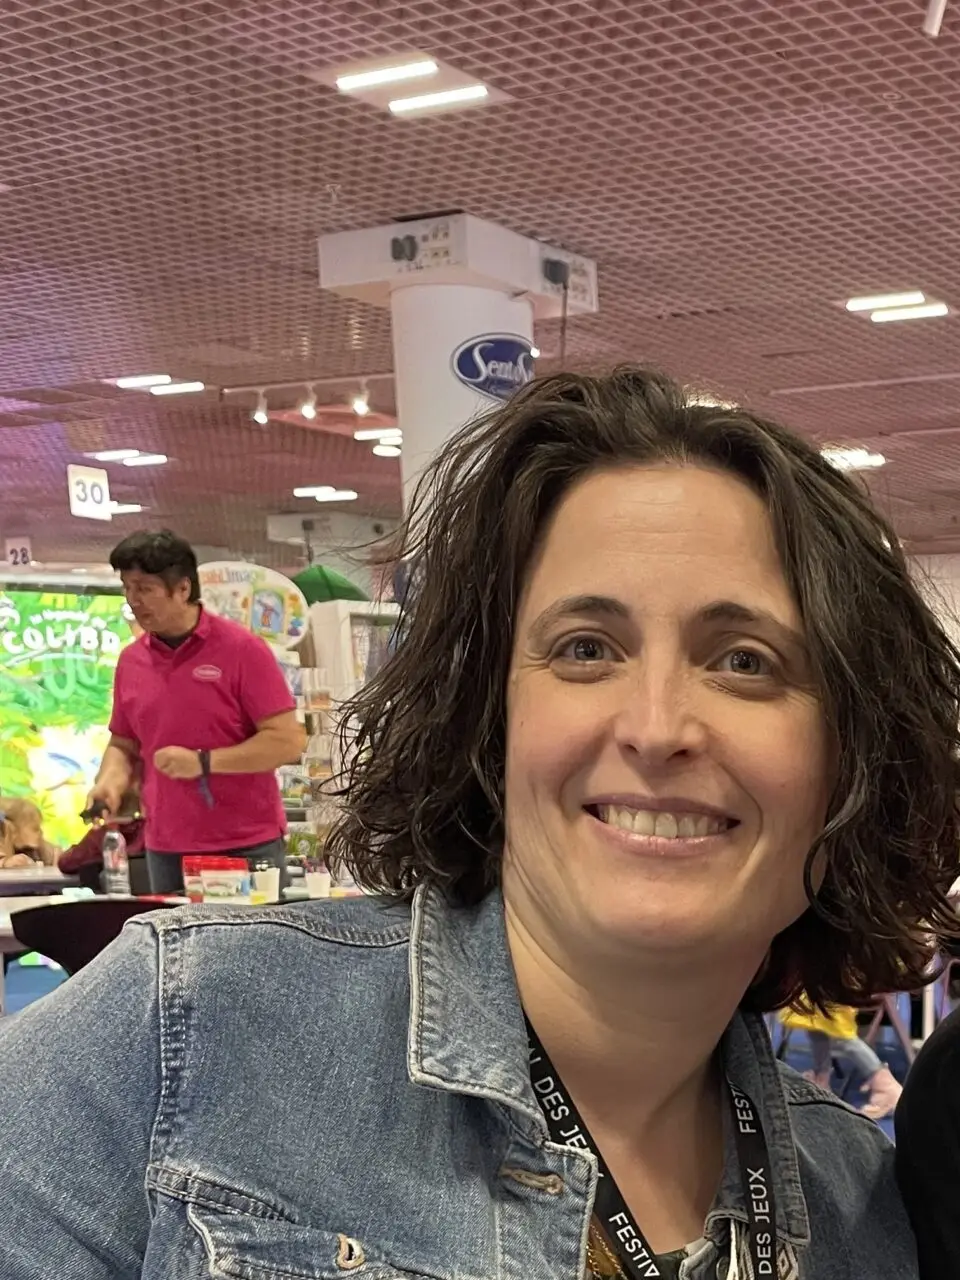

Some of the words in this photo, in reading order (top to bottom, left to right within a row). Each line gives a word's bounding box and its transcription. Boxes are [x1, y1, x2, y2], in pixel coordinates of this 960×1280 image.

[75, 479, 104, 504] 30
[10, 548, 30, 565] 28
[534, 1076, 570, 1121] DES
[747, 1167, 770, 1225] JEUX
[756, 1232, 774, 1275] DES
